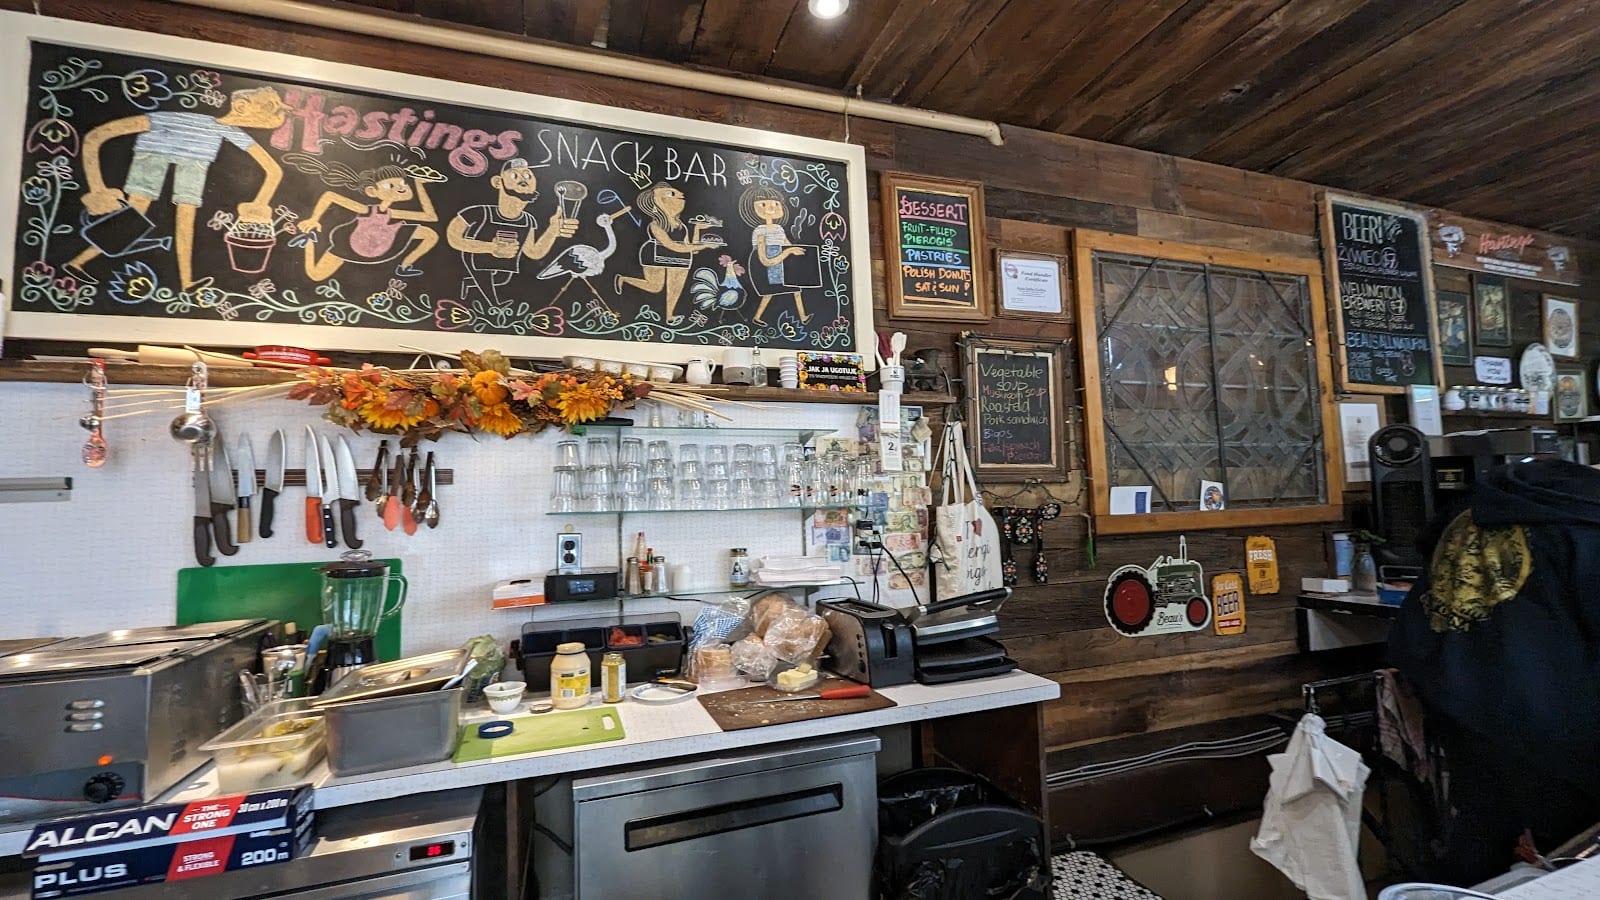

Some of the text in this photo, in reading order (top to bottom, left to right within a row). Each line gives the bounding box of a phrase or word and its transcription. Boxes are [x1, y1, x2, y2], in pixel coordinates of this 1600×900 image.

[270, 90, 522, 176] Hastings
[536, 129, 727, 187] SNACK BAR
[900, 195, 967, 220] DESSERT
[1342, 212, 1383, 244] BEER!
[904, 234, 953, 246] PIEROGIS
[903, 266, 971, 281] POLISH DONUTS
[915, 282, 930, 292] SAT
[939, 282, 960, 293] SUN
[1341, 281, 1402, 299] WELLINGTON
[980, 363, 1043, 383] Vegetable
[983, 411, 1048, 425] Pork sandwich
[888, 442, 895, 450] 2
[1248, 550, 1273, 562] FRESH
[1217, 591, 1240, 616] BEER
[1157, 611, 1184, 626] Beau's
[202, 804, 219, 812] THE
[183, 809, 231, 823] STRONG
[26, 813, 178, 851] ALCAN
[192, 819, 217, 830] ONE
[183, 852, 215, 863] STRONG
[35, 863, 128, 889] PLUS
